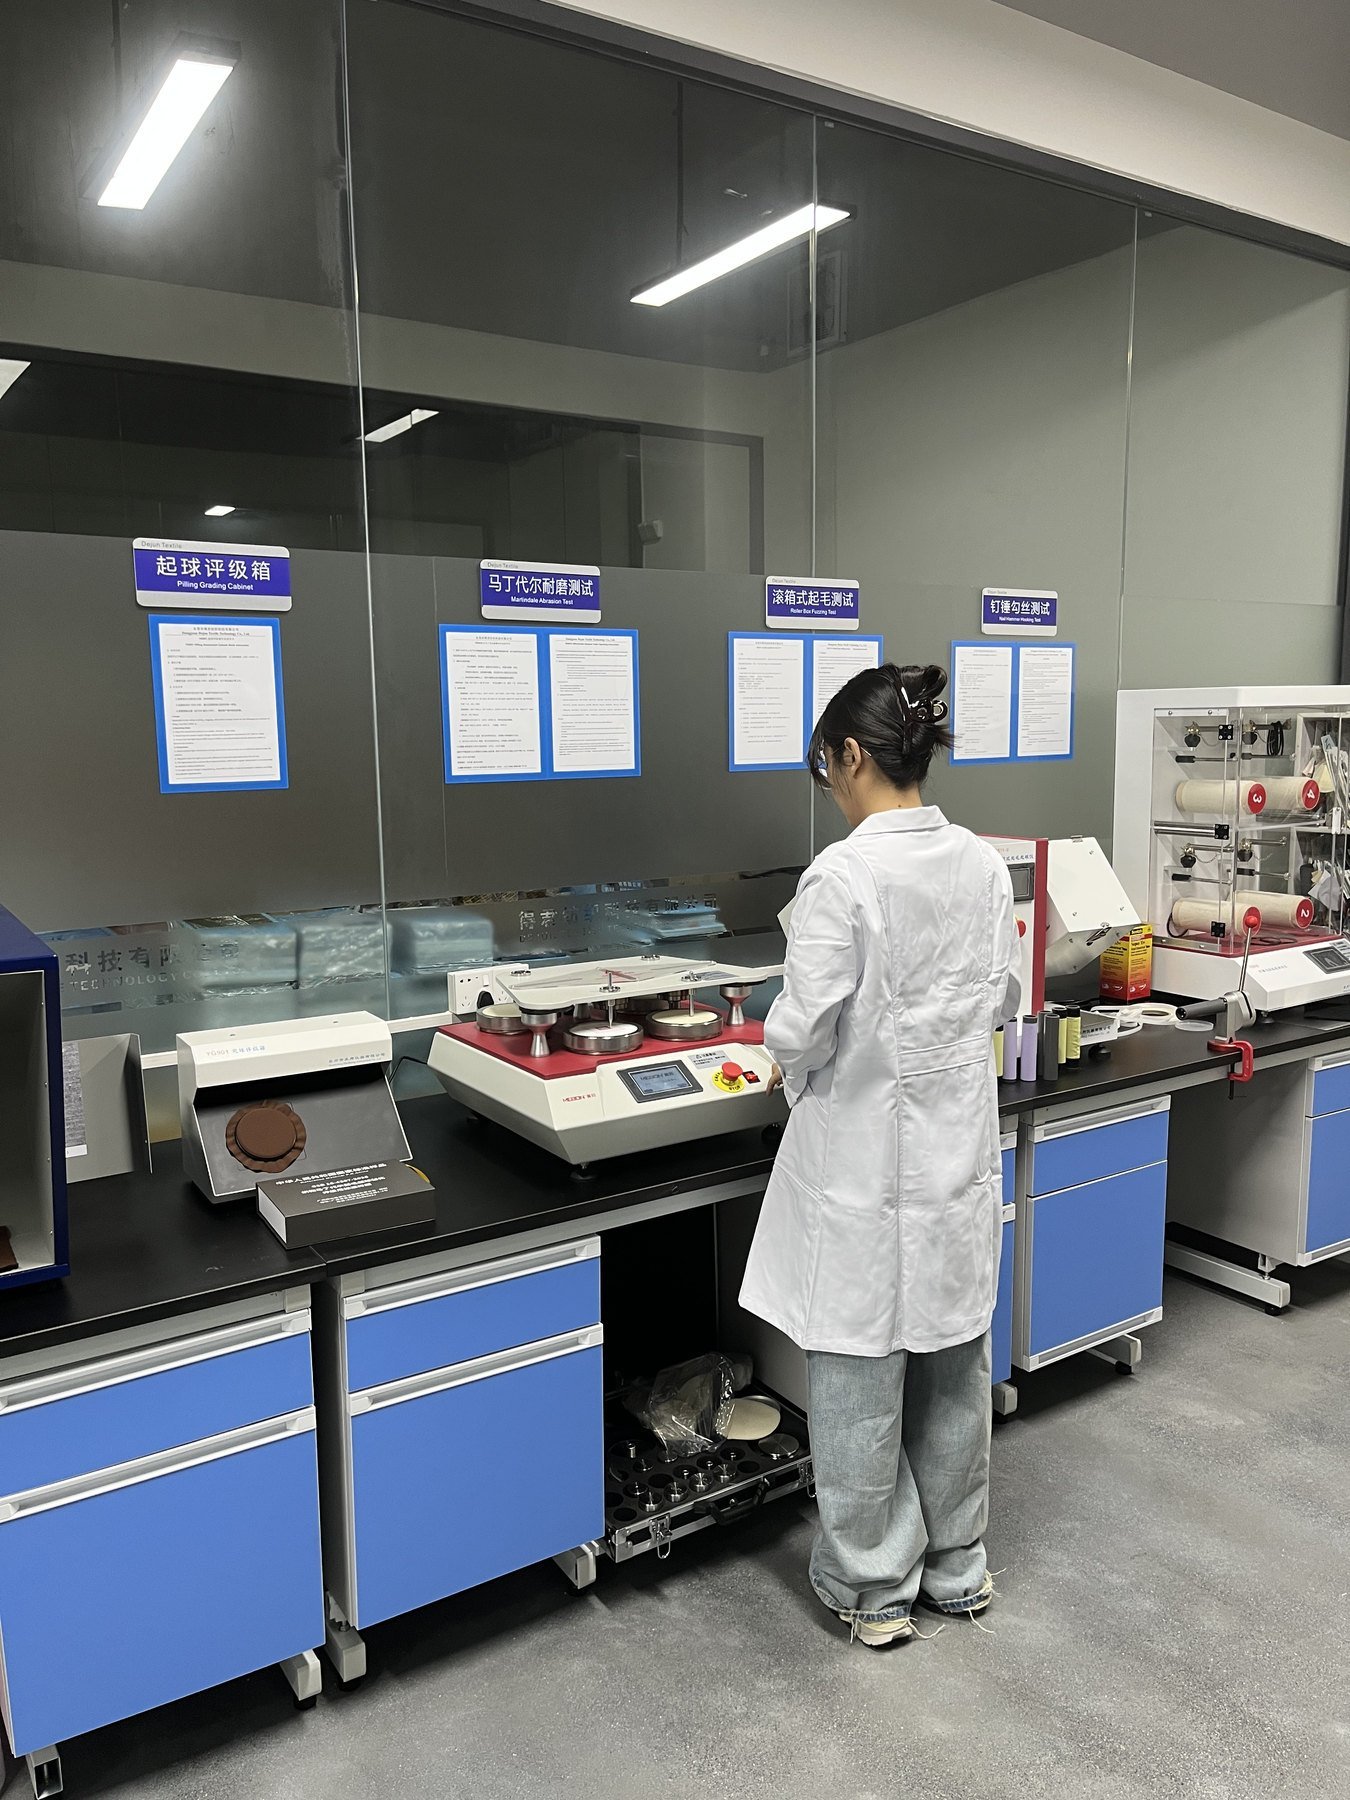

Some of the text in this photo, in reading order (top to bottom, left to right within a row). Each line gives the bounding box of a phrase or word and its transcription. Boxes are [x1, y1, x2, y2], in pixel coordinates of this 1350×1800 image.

[162, 541, 182, 549] Textile
[156, 555, 271, 581] 起球评级箱
[177, 580, 254, 591] Pilling Grading Cabinet
[488, 574, 594, 597] 马丁代尔耐磨测试
[510, 596, 538, 604] Martindale
[539, 597, 561, 605] Abrasion
[772, 589, 854, 608] 滚箱式起毛测试
[811, 608, 828, 616] Fuzzing
[990, 599, 1050, 616] 钉锤勾丝测试
[1253, 794, 1262, 803] 3
[1306, 789, 1315, 799] 4
[1301, 908, 1310, 918] 2
